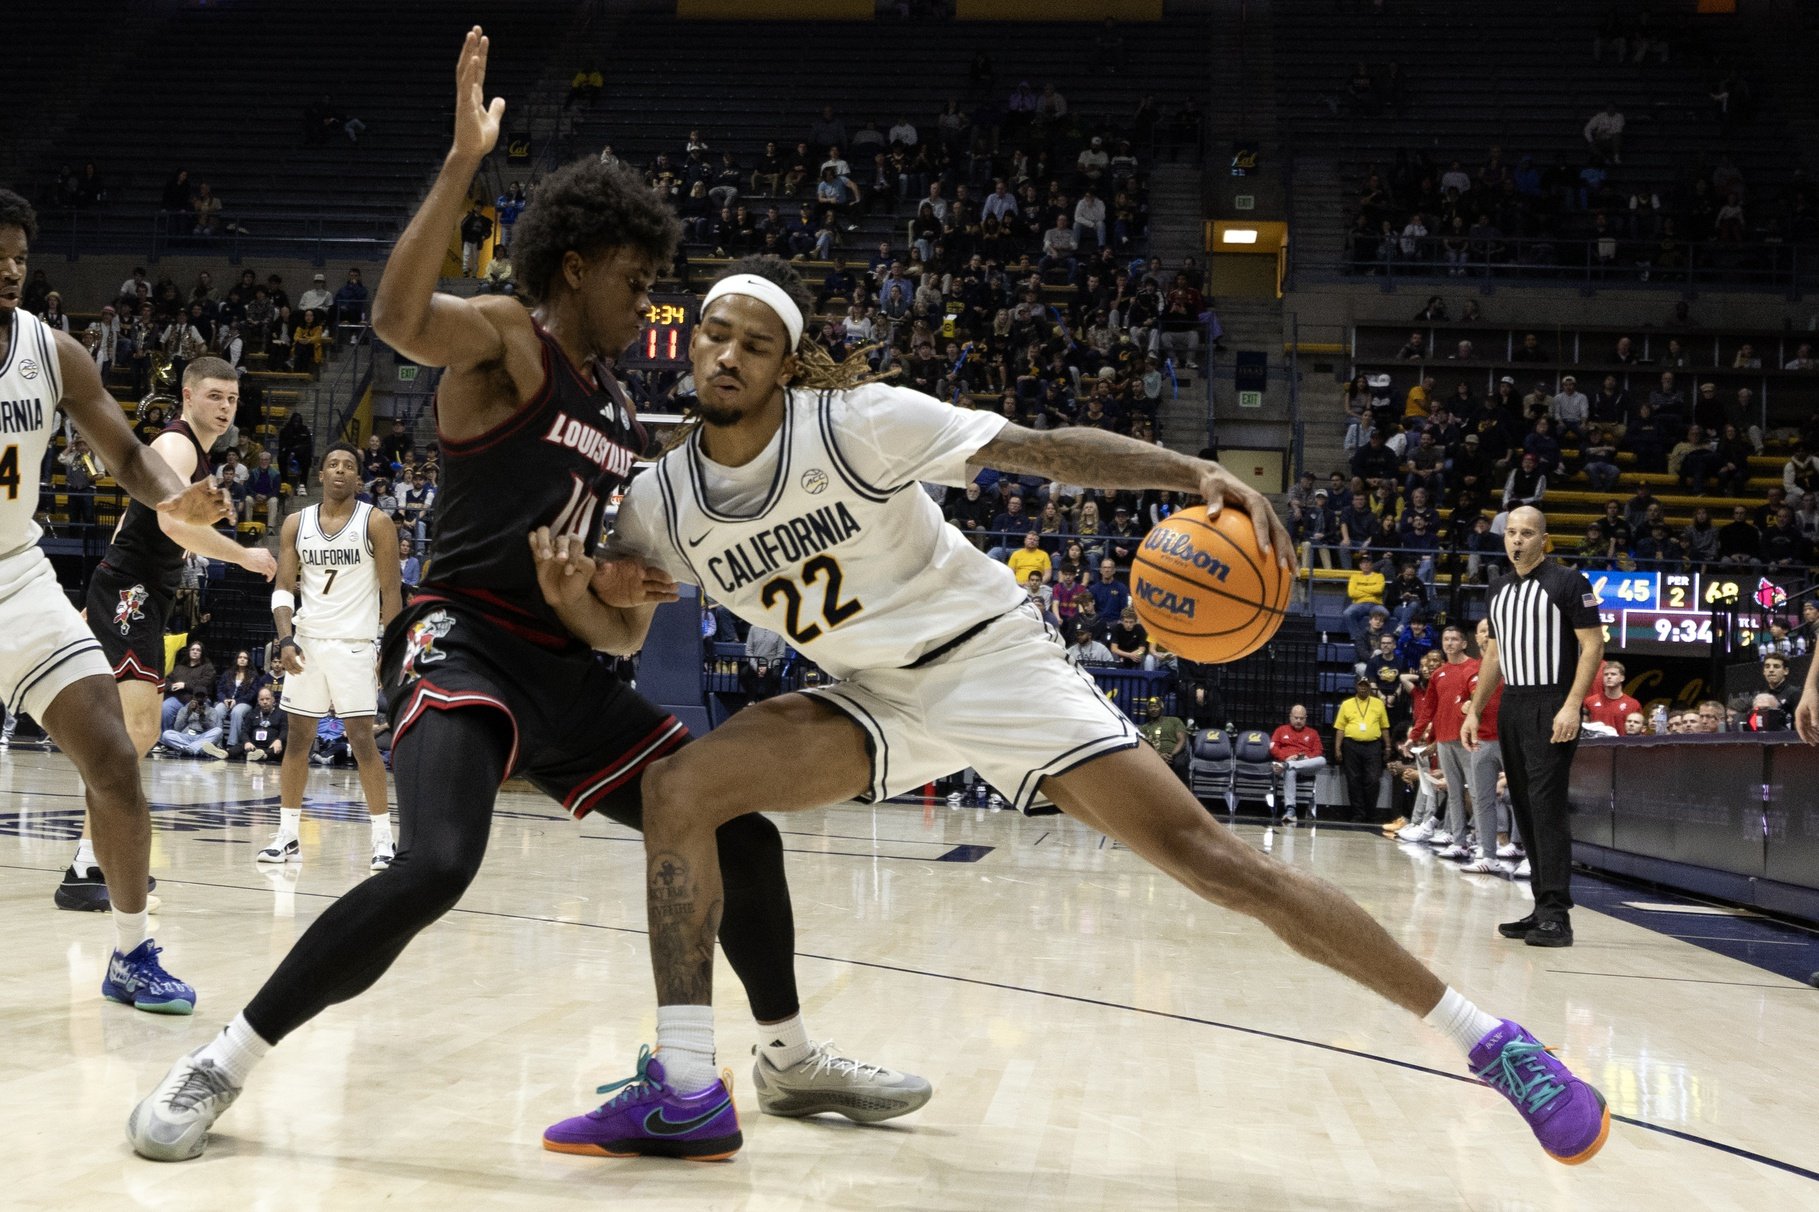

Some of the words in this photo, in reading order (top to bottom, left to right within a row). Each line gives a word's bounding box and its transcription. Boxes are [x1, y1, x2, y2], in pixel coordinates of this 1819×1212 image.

[508, 140, 530, 158] Cal
[646, 328, 677, 359] 11
[401, 368, 415, 379] EXIT
[1242, 393, 1258, 405] EXIT
[0, 398, 43, 434] RNIA
[302, 549, 361, 566] CALIFORNIA
[707, 501, 862, 593] CALIFORNIA
[1144, 527, 1231, 584] Wilson
[322, 569, 339, 595] 7
[1617, 578, 1650, 602] 45
[1667, 576, 1690, 586] PER
[761, 553, 864, 644] 22
[1136, 577, 1196, 619] NCAA
[1669, 587, 1685, 608] 2
[1655, 618, 1713, 644] 9:34
